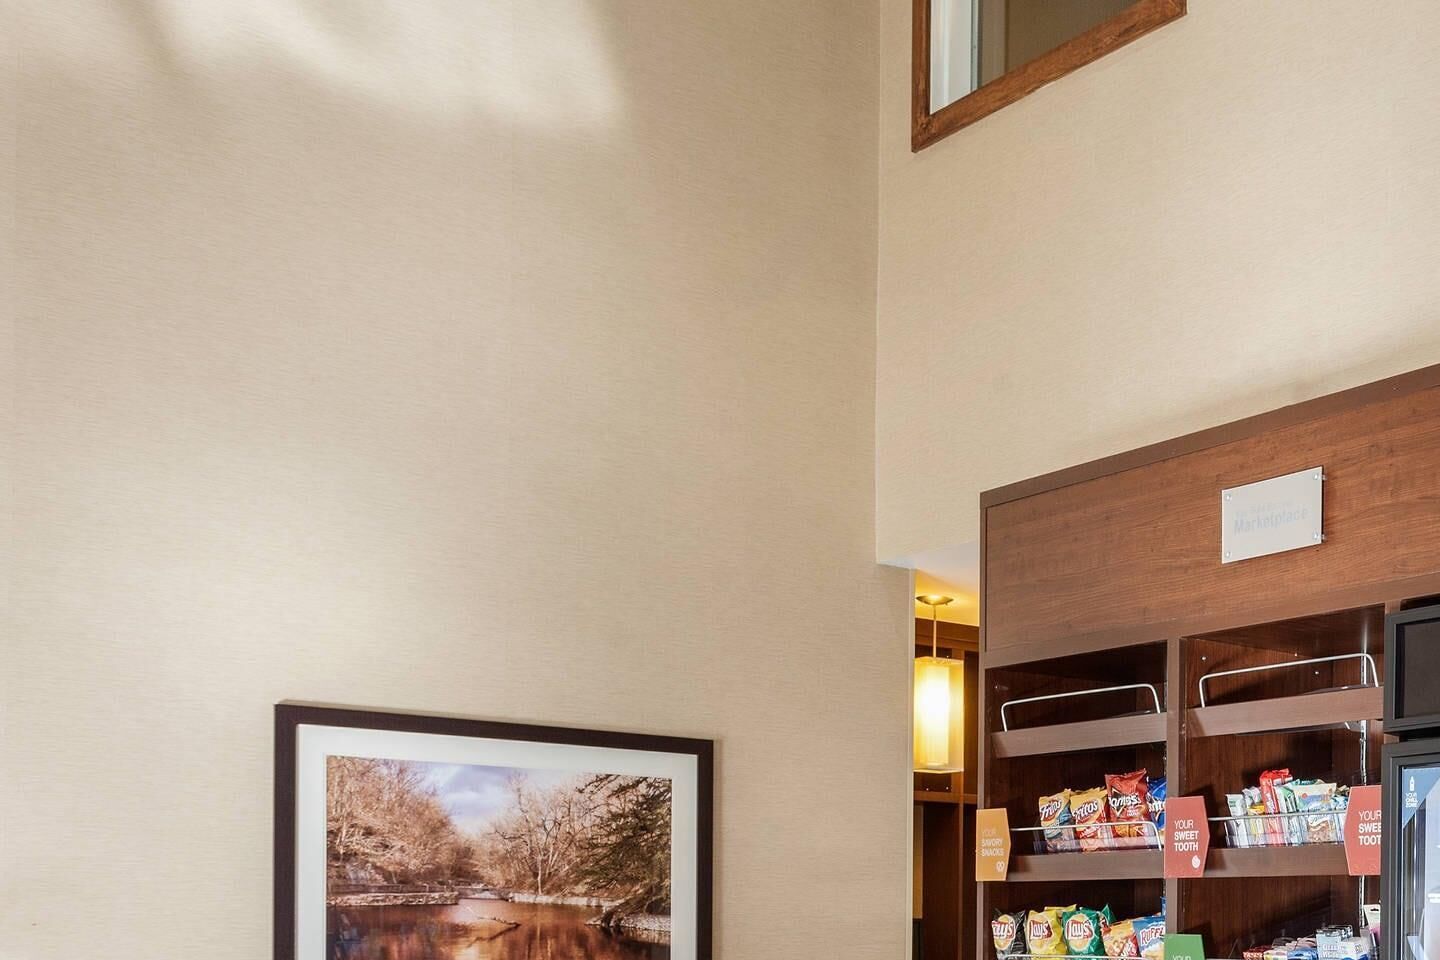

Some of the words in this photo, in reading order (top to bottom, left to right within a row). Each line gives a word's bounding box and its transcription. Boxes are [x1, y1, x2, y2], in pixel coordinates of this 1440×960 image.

[1039, 799, 1062, 821] Fritos
[1174, 820, 1194, 829] YOUR
[1358, 823, 1381, 833] SWEE
[1174, 831, 1199, 840] SWEET
[1358, 835, 1381, 846] TOOT
[982, 839, 1004, 848] SAVORY
[1174, 842, 1199, 852] TOOTH
[982, 848, 1005, 857] SNACKS
[1030, 920, 1049, 940] Lay's
[1068, 919, 1094, 940] Lay's
[1141, 925, 1165, 947] RUFFL
